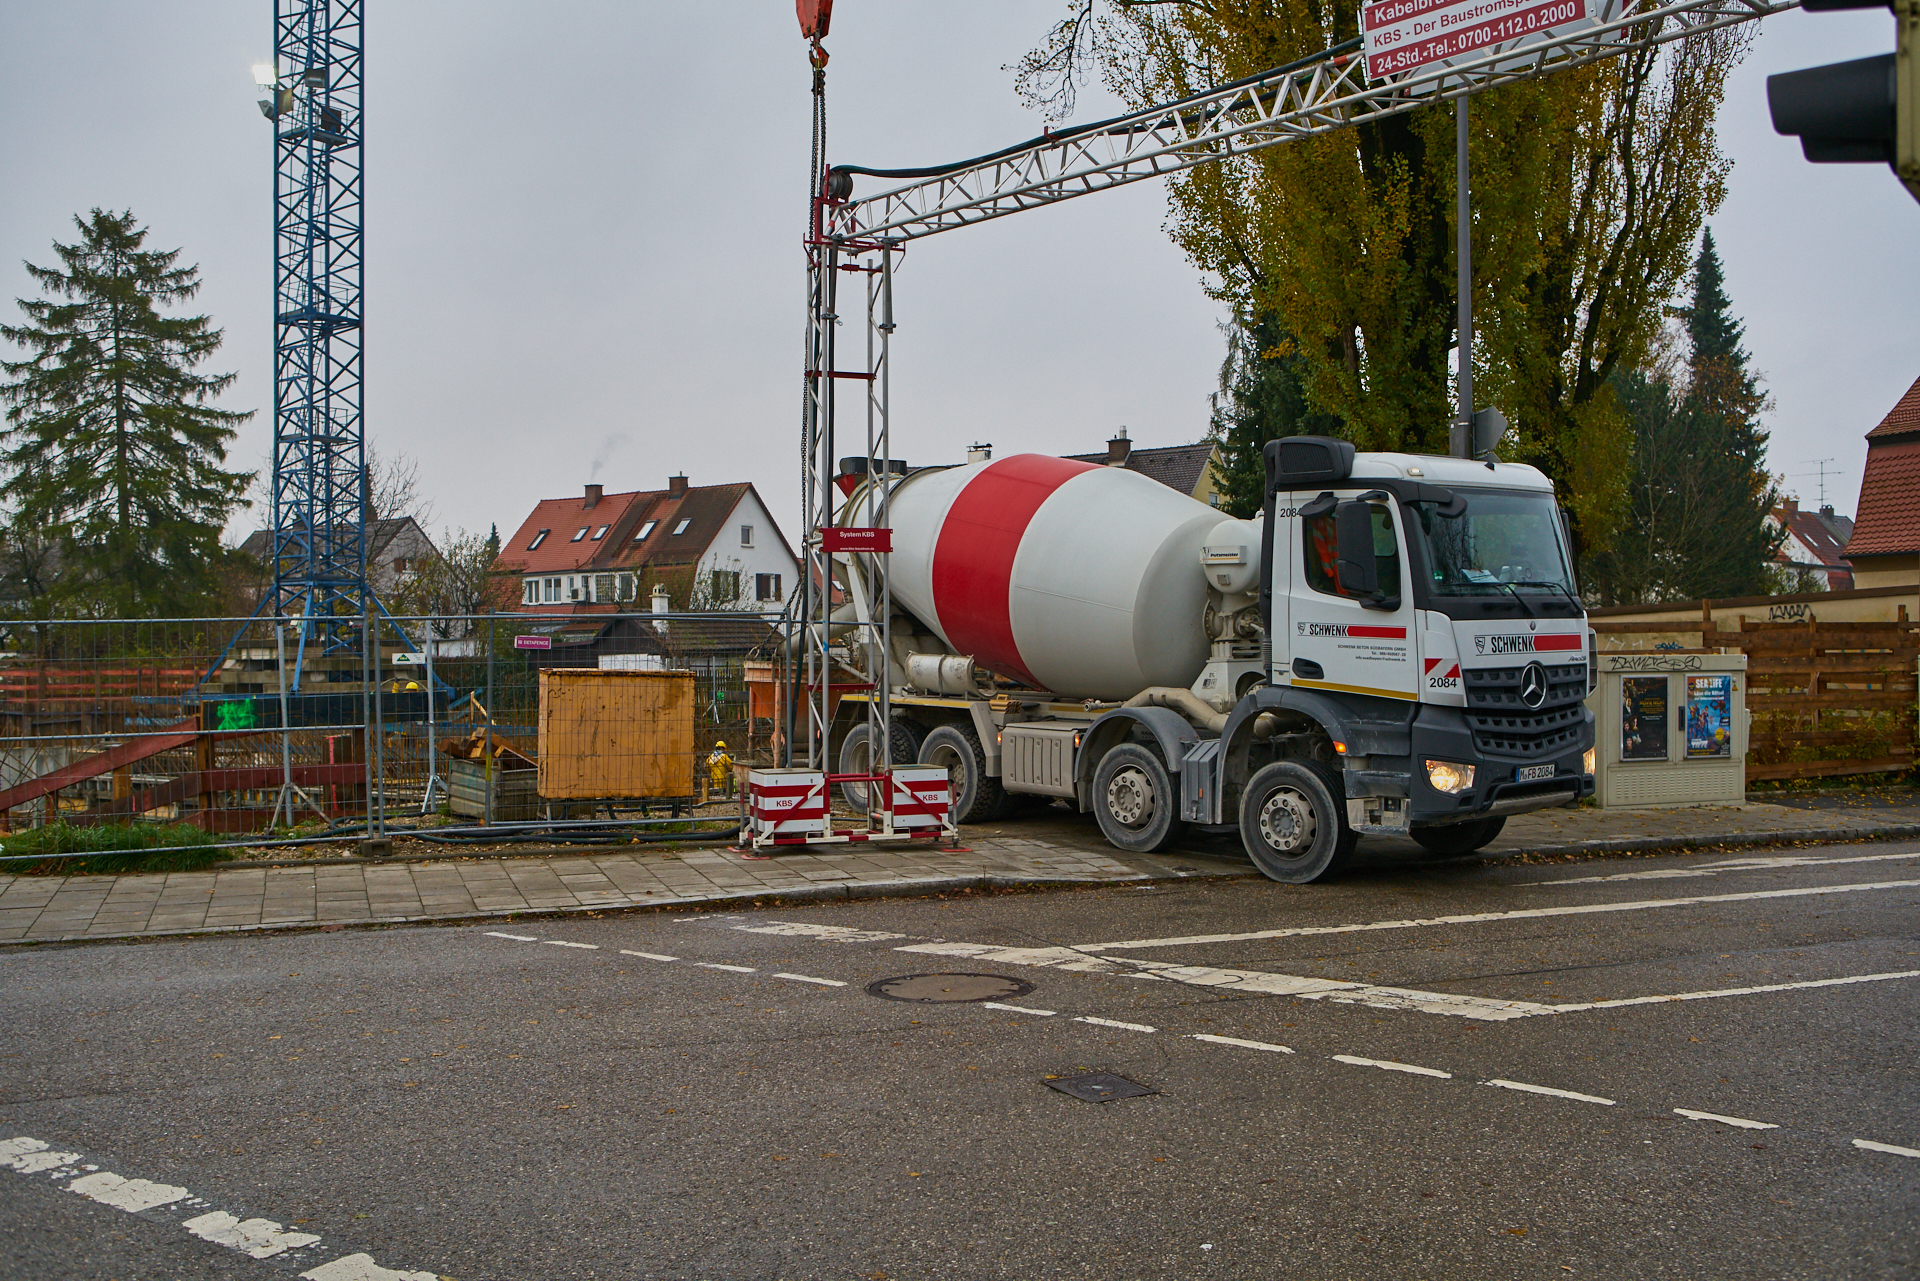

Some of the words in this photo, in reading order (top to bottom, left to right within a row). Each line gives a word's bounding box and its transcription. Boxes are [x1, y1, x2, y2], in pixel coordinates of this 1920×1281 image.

[1374, 29, 1402, 47] KBS
[1413, 20, 1436, 36] Der
[1440, 0, 1530, 28] Baustromsp
[1309, 623, 1348, 637] SCHWENK
[1490, 635, 1535, 653] SCHWENK
[1429, 677, 1457, 688] 2084
[1695, 678, 1709, 689] SEA
[1519, 769, 1525, 781] M
[1528, 767, 1537, 780] FB
[1537, 765, 1554, 778] 2084
[776, 799, 793, 808] KBS
